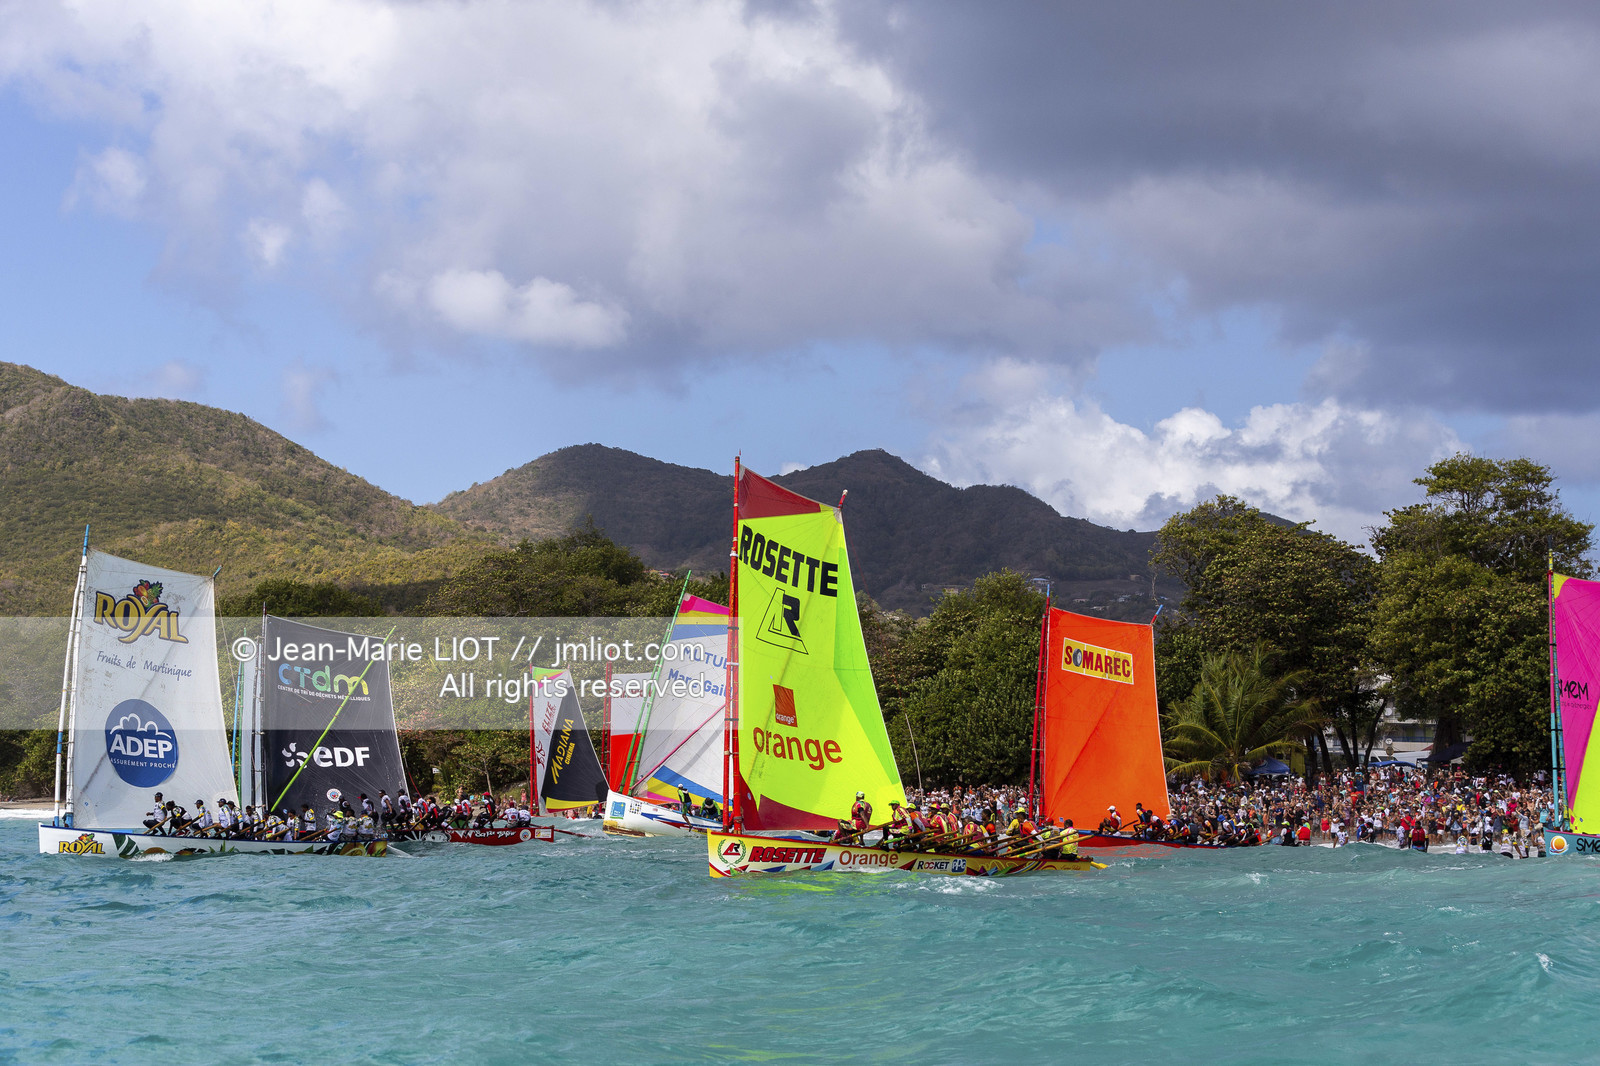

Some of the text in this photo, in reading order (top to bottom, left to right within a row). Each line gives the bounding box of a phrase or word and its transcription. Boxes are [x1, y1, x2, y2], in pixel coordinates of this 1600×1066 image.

[739, 524, 838, 597] ROSETTE
[93, 591, 189, 644] ROYAL
[96, 650, 192, 681] Fruits de Martinique
[776, 713, 794, 724] orange
[110, 733, 173, 759] ADEP
[551, 718, 574, 785] MADIANA
[753, 727, 843, 771] orange
[58, 839, 106, 856] ROYAL
[748, 846, 827, 864] ROSETTE
[839, 850, 899, 867] Orange
[917, 860, 950, 870] ROCKET
